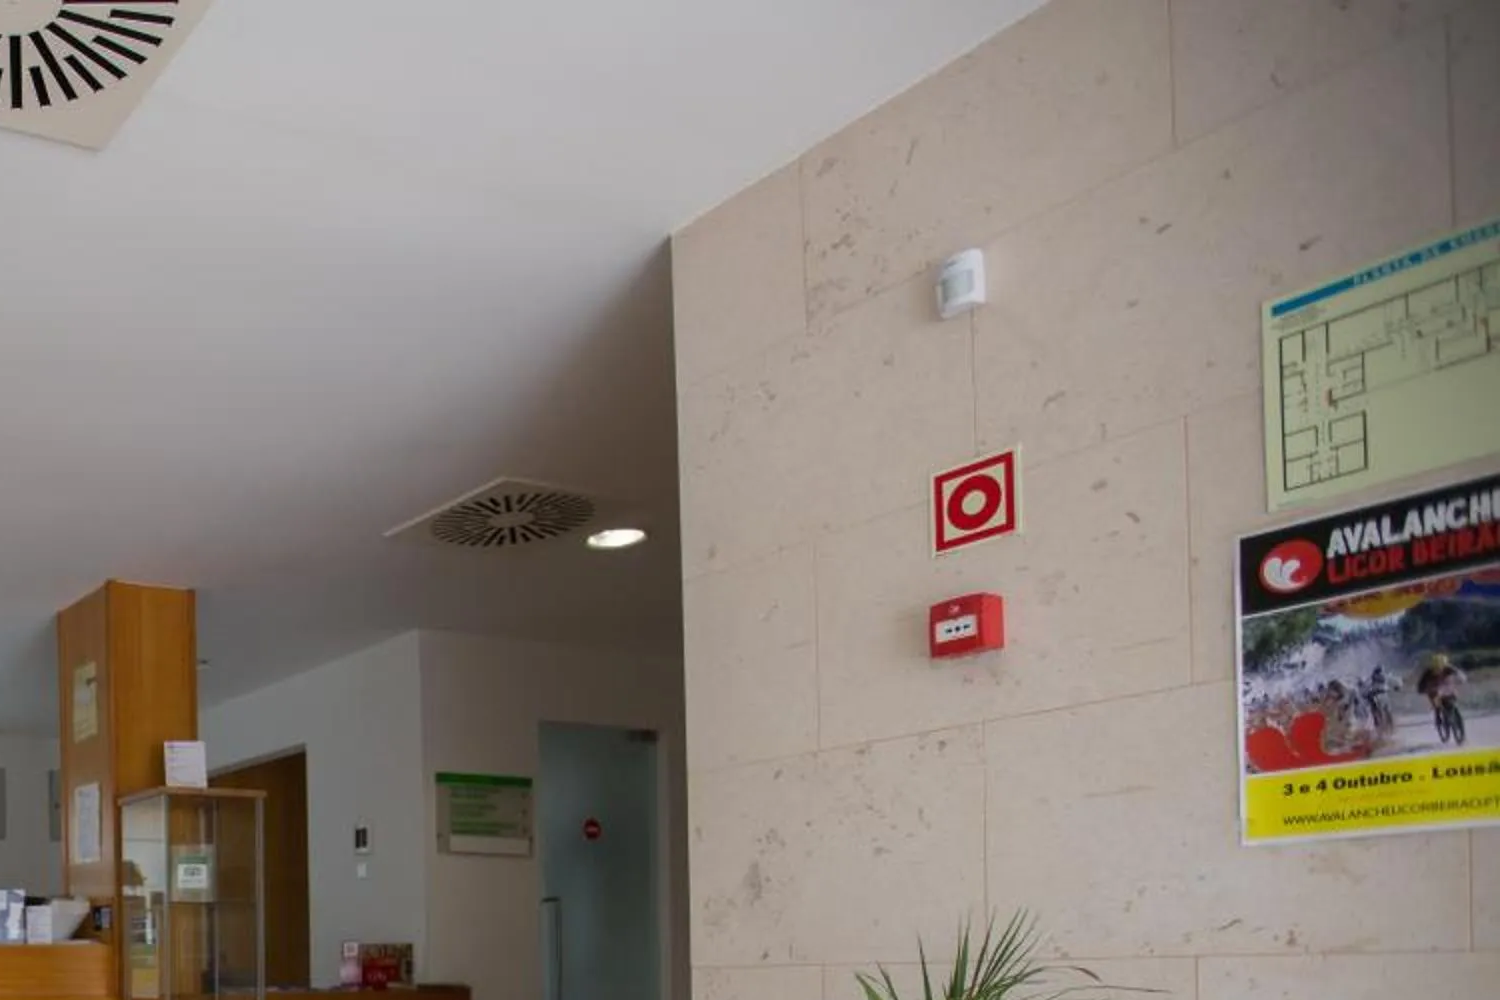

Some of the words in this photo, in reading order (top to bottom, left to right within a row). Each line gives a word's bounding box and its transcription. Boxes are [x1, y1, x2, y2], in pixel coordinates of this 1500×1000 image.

[1326, 543, 1406, 585] LICOR
[1412, 517, 1500, 566] BEIRÃ
[1283, 783, 1294, 796] 3
[1315, 779, 1328, 792] 4
[1332, 771, 1413, 790] Outubro
